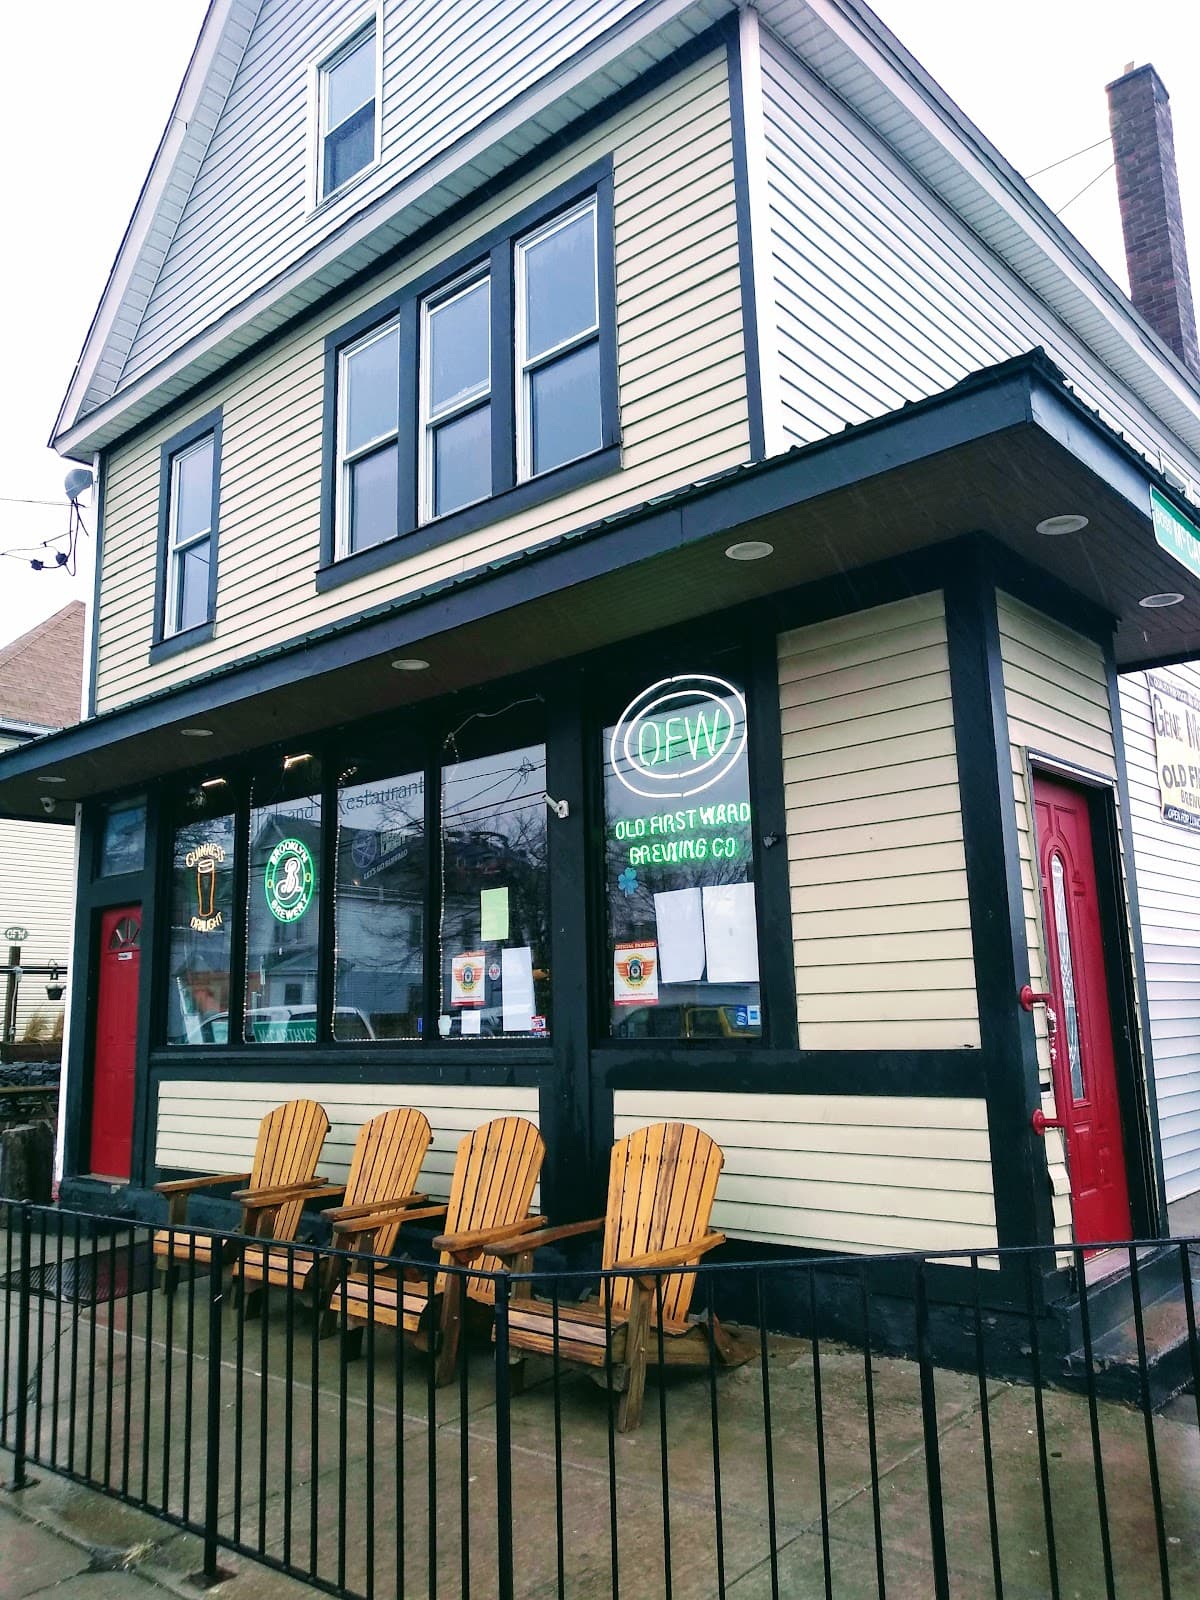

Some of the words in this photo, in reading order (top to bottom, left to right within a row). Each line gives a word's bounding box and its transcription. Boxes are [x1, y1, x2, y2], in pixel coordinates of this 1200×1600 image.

[638, 708, 721, 767] OFW
[1162, 764, 1187, 789] OLD
[615, 818, 645, 840] OLD
[650, 809, 697, 835] FIRST
[699, 802, 751, 825] WARD
[186, 843, 226, 868] GUINNESS
[270, 841, 308, 866] BROOKLYN
[629, 838, 707, 865] BREWING
[712, 837, 736, 857] CO
[271, 893, 308, 920] BREWERY
[189, 911, 223, 932] DRAUGHT
